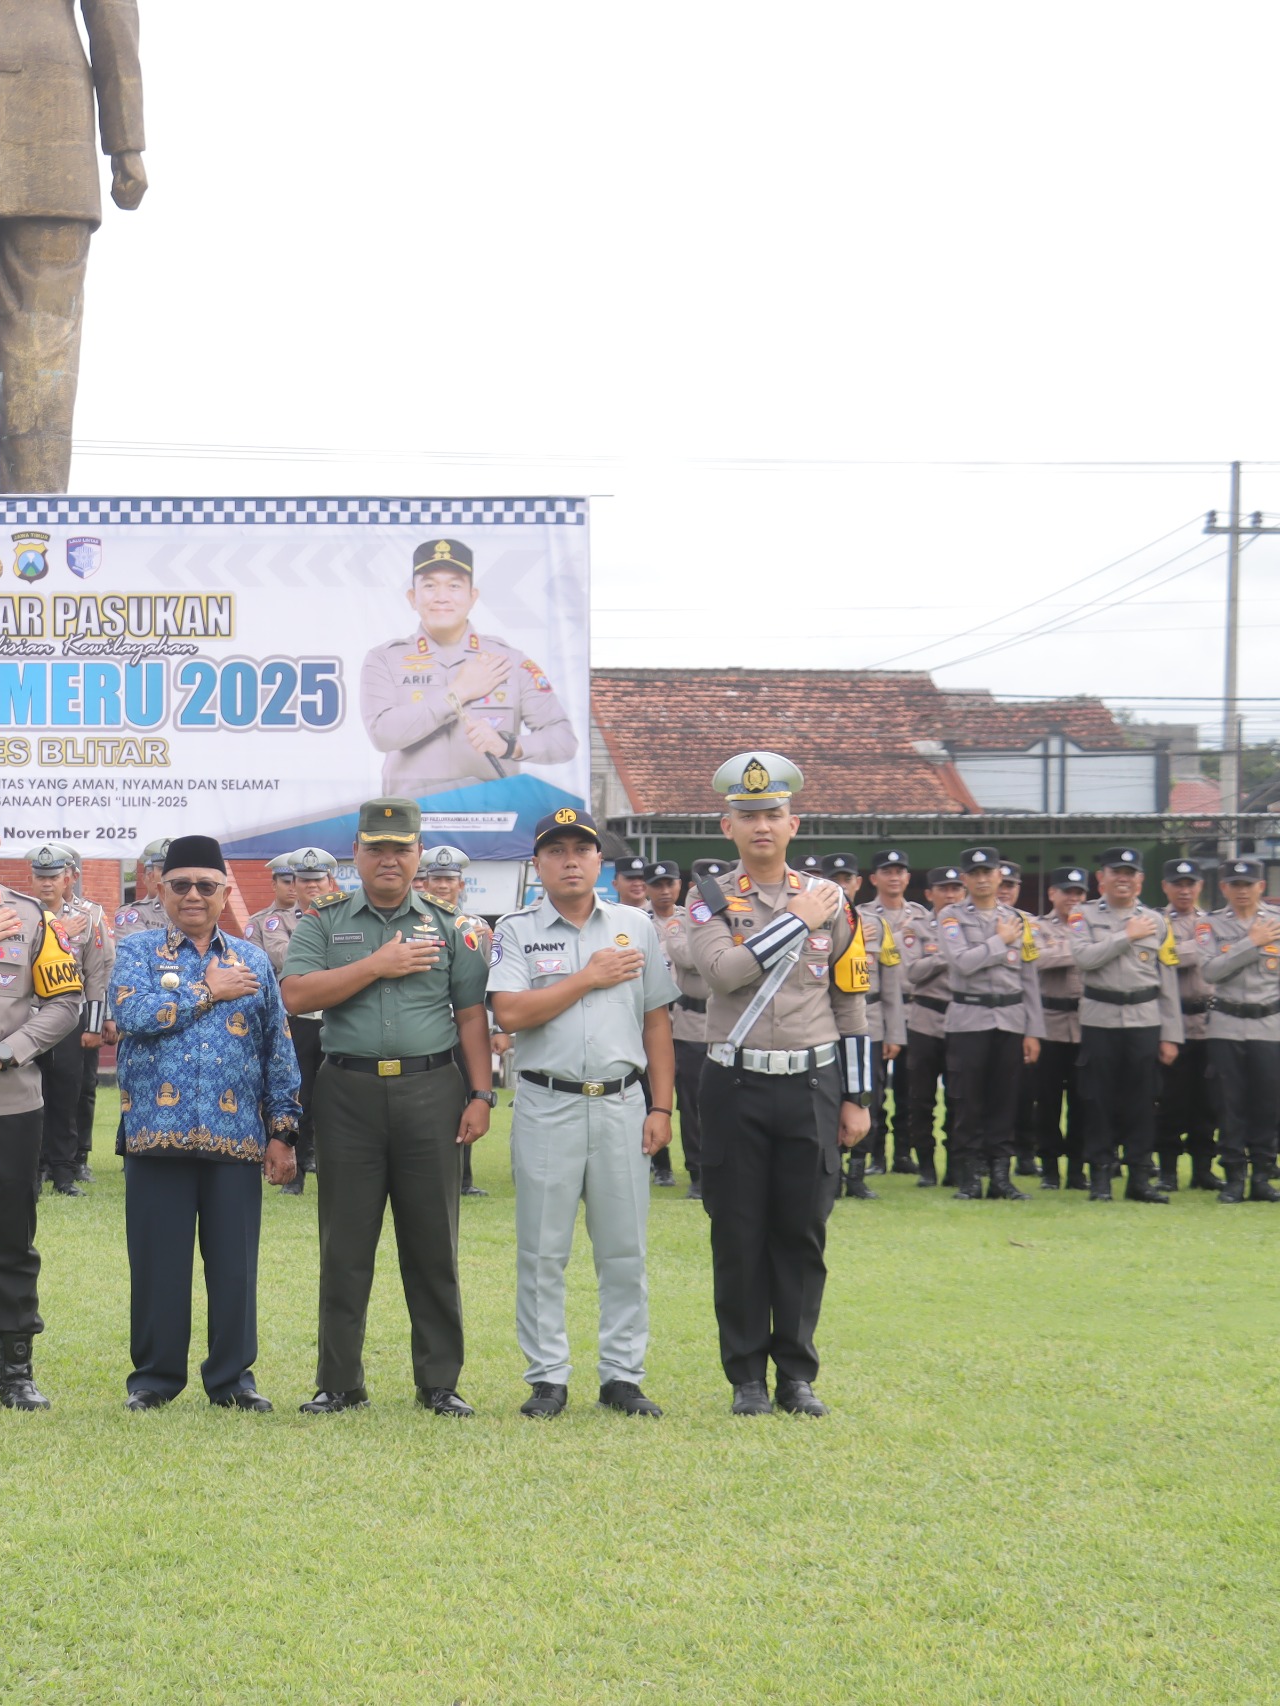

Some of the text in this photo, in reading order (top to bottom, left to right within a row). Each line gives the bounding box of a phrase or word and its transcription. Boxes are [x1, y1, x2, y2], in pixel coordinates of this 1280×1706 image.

[53, 596, 232, 638] PASUKAN
[61, 632, 200, 668] Kewilayahan
[402, 675, 434, 685] ARIF
[179, 661, 339, 727] 2025
[40, 739, 169, 766] BLITAR
[28, 778, 68, 791] YANG
[72, 778, 118, 793] AMAN,
[122, 778, 184, 791] NYAMAN
[187, 778, 218, 791] DAN
[221, 778, 281, 791] SELAMAT
[55, 796, 111, 808] OPERASI
[3, 826, 138, 840] November 2025
[524, 942, 566, 954] DANNY
